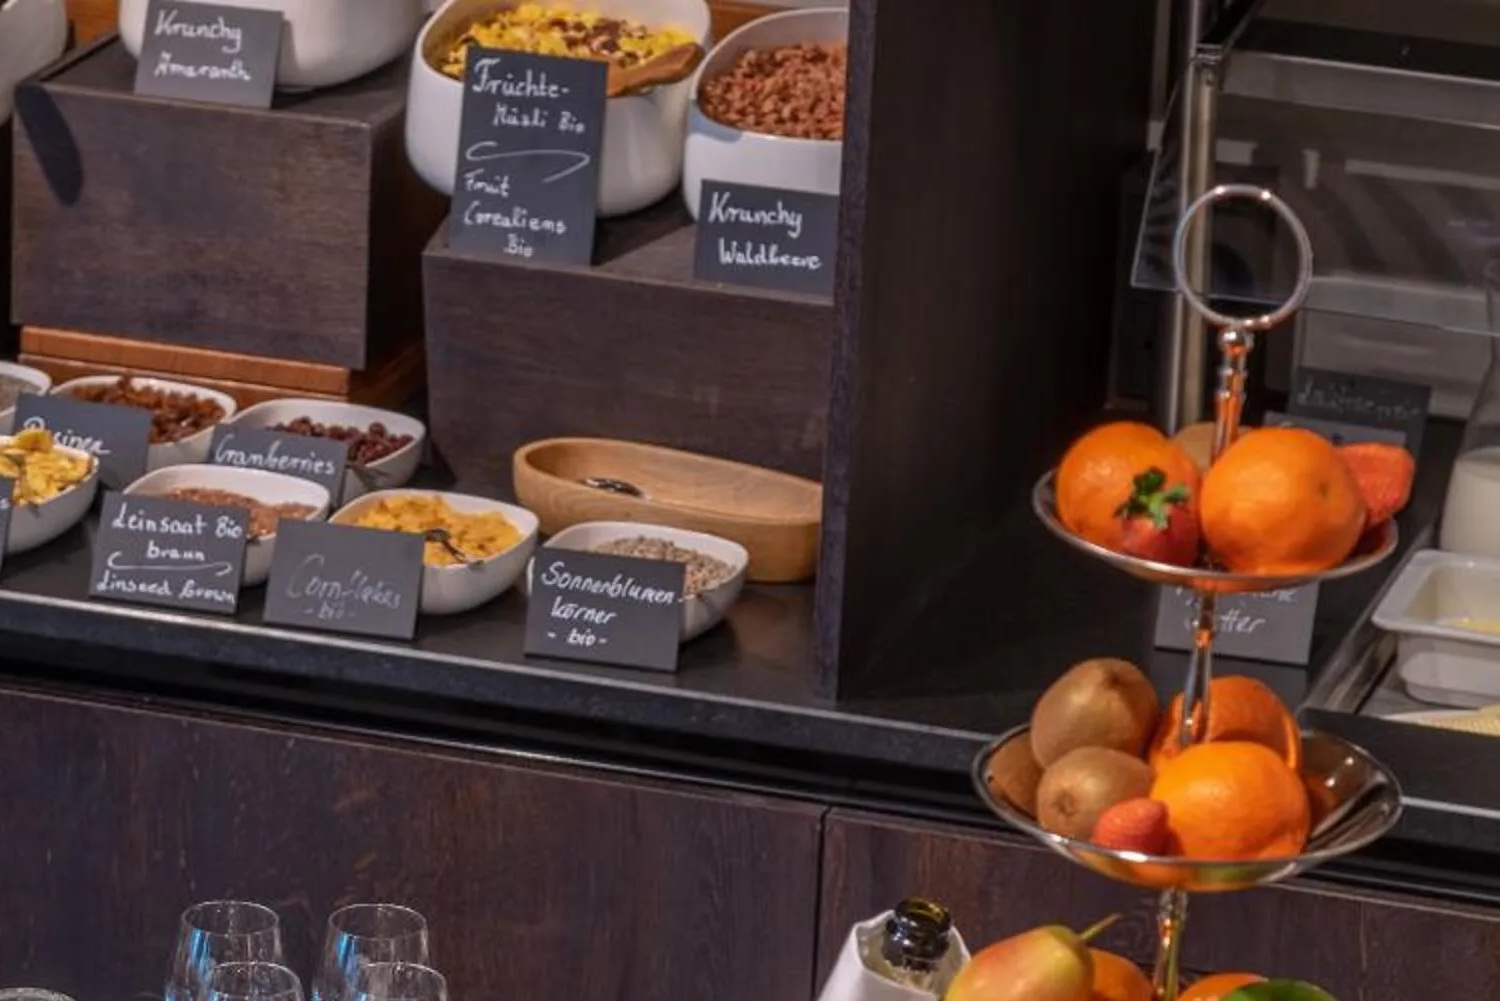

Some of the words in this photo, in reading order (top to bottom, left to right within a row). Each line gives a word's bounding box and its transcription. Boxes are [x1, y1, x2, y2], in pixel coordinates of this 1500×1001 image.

[154, 9, 242, 54] Krunchy
[154, 51, 251, 81] Amaranth
[472, 58, 570, 98] Früchte-
[493, 102, 549, 127] Müsli
[558, 111, 585, 133] Bio
[463, 168, 510, 198] Fruit
[708, 191, 803, 239] Krunchy
[503, 233, 534, 257] Bio
[214, 433, 336, 475] Cranberries
[215, 515, 243, 538] Bio
[146, 540, 205, 561] braun
[96, 569, 172, 596] Linseed
